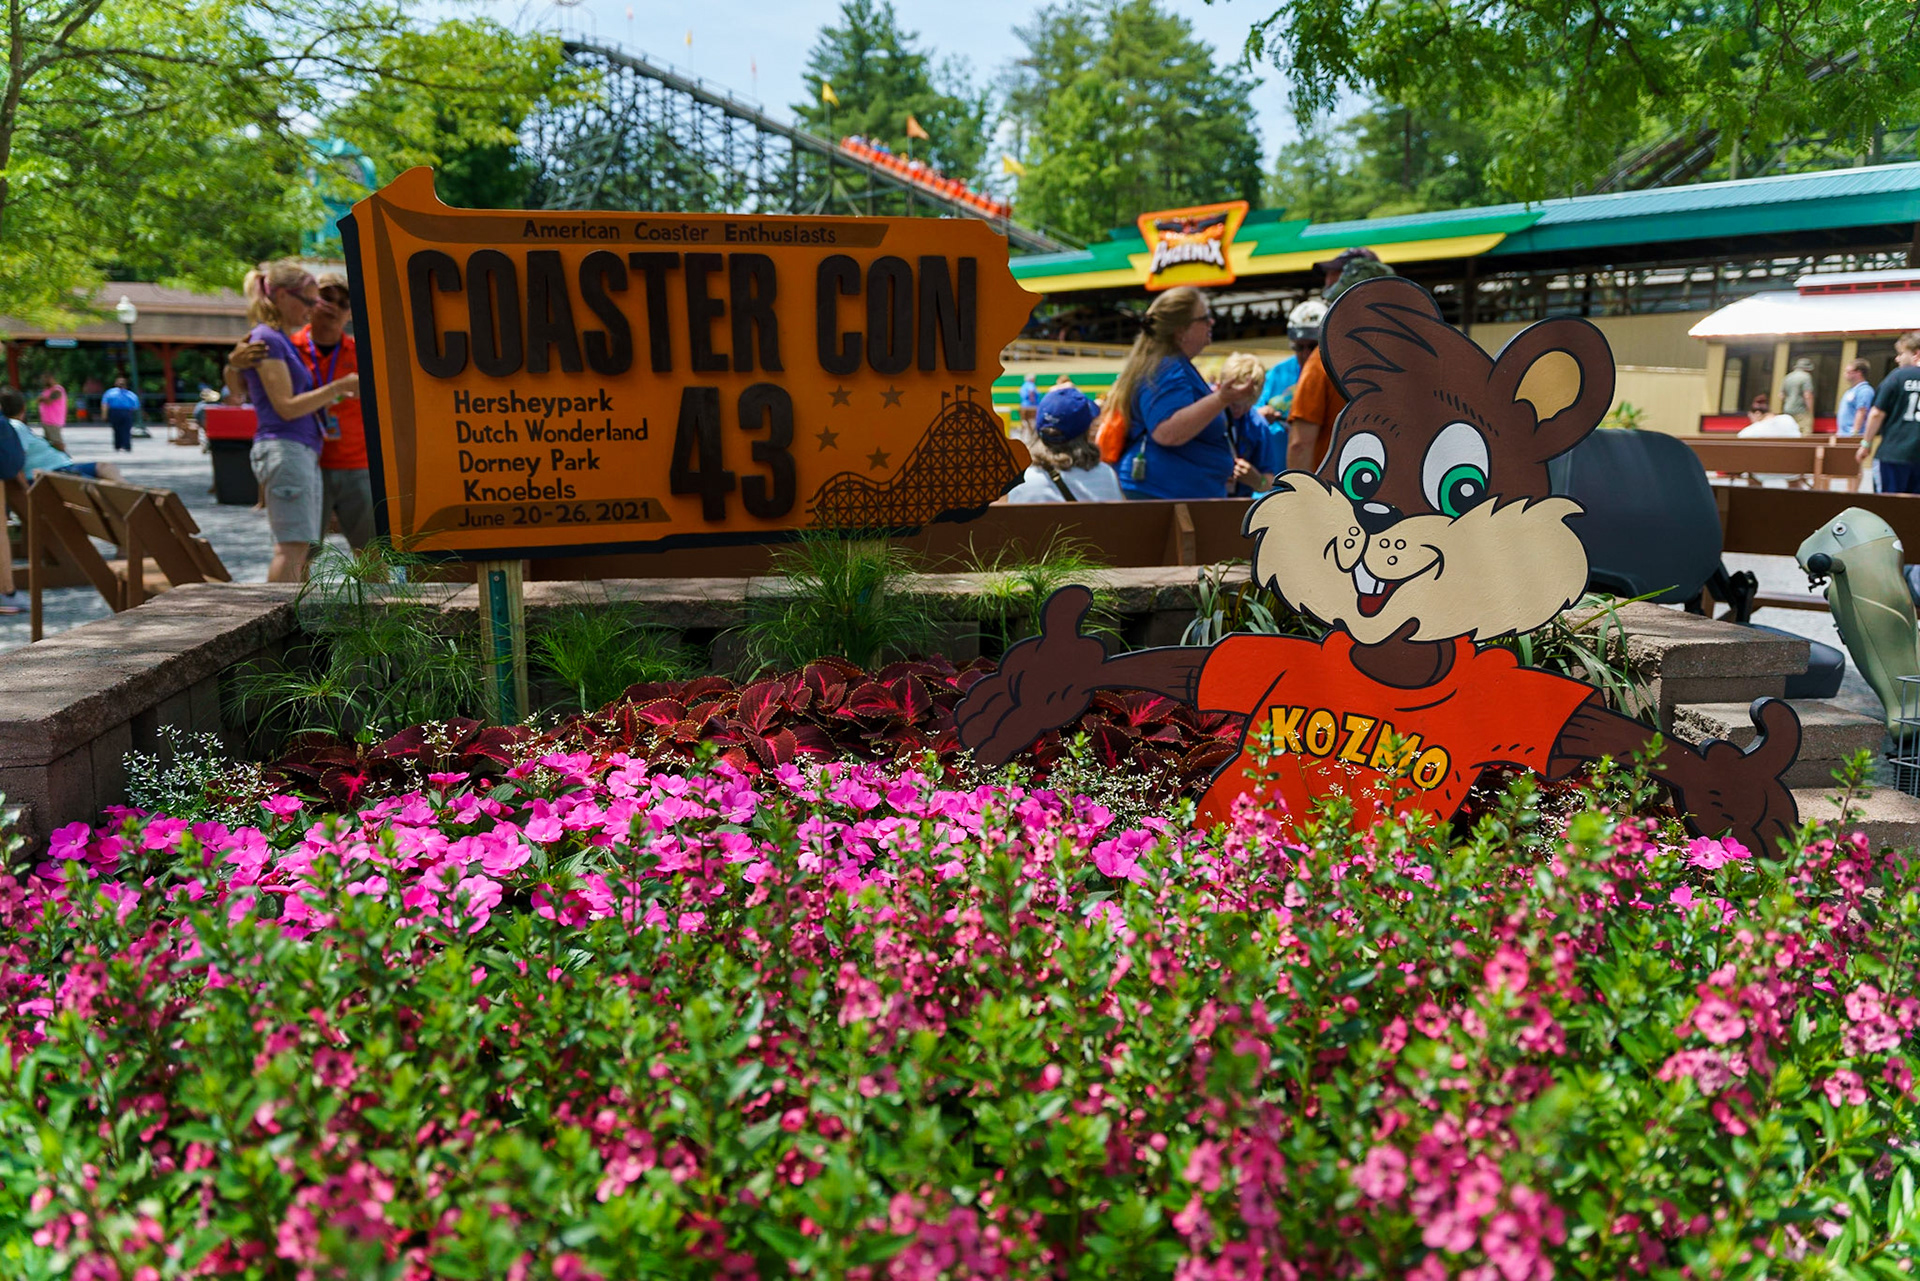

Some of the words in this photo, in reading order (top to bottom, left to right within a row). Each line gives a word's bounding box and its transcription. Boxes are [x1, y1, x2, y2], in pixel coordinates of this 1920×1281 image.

[523, 219, 621, 240] American
[634, 221, 709, 242] Coaster
[724, 223, 836, 243] Enthusiasts
[406, 248, 785, 379] COASTER
[816, 254, 977, 376] CON
[453, 388, 615, 419] Hersheypark
[456, 419, 519, 444] Dutch
[524, 417, 649, 443] Wonderland
[458, 449, 541, 478] Dorney
[551, 447, 601, 471] Park
[669, 382, 797, 522] 43
[463, 477, 577, 502] Knoebels
[457, 507, 506, 528] June
[596, 501, 651, 522] 2021
[1267, 705, 1451, 791] KOZMO
